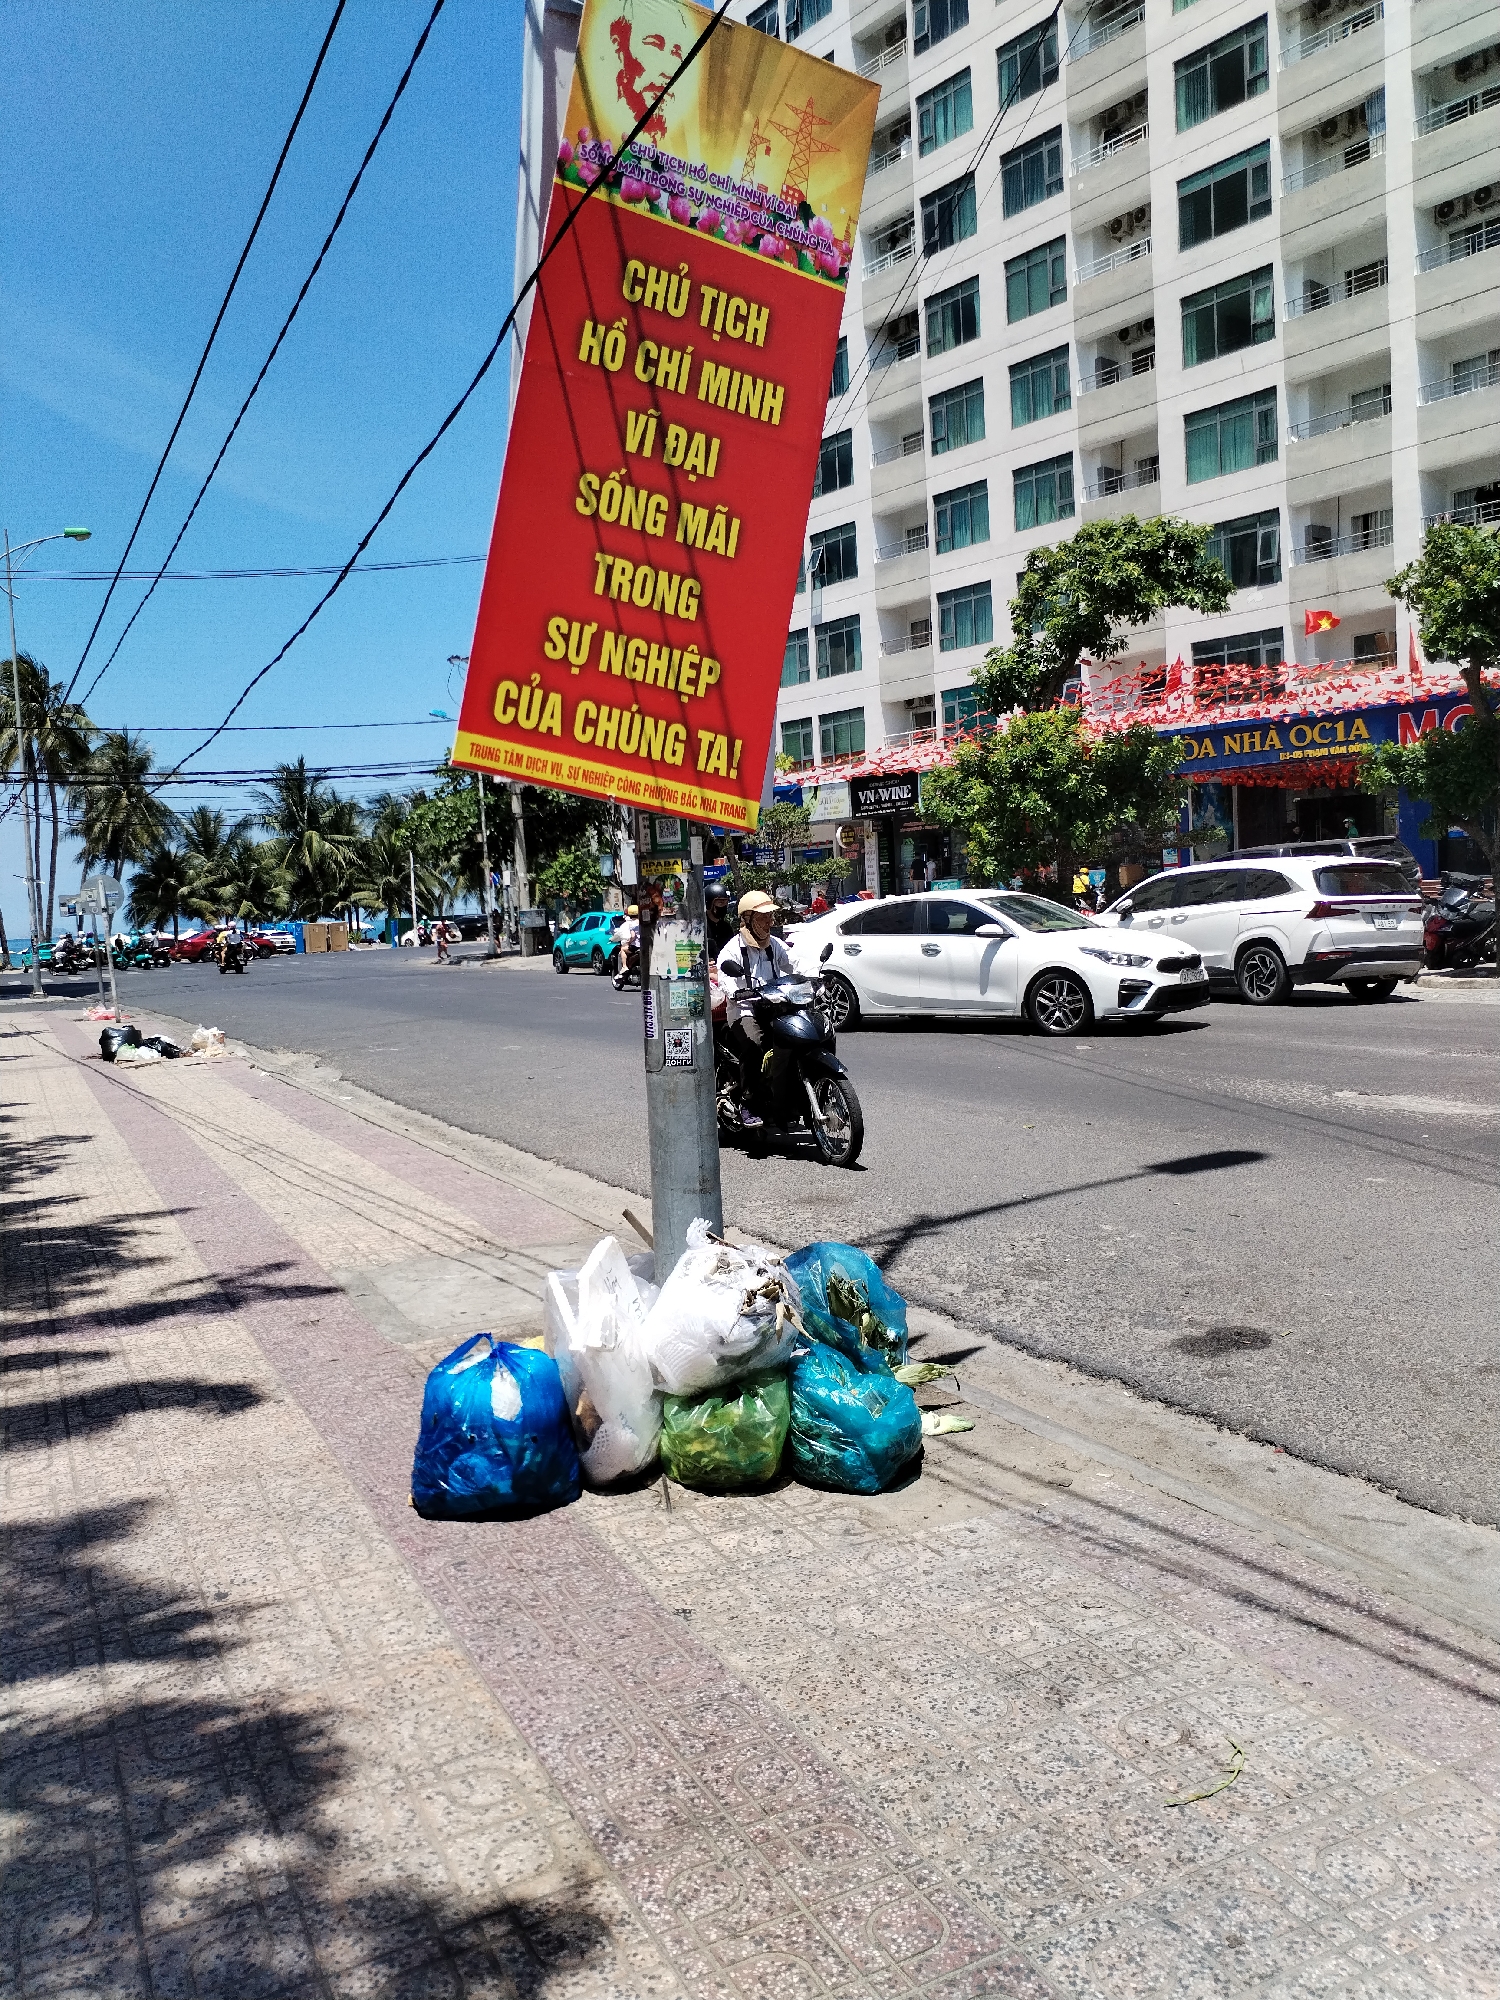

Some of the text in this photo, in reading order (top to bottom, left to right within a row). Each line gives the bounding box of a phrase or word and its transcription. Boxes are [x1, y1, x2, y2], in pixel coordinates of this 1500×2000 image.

[619, 160, 642, 180] MÃI
[643, 168, 686, 195] TRONG
[687, 186, 706, 205] SỰ
[706, 194, 750, 222] NGHIỆP
[750, 211, 774, 231] CỦA
[776, 222, 818, 249] CHÚNG
[818, 237, 834, 256] TA
[629, 140, 797, 221] CHỦ TỊCH HỒ CHÍ MINH VĨ ĐẠI
[622, 259, 770, 348] CHỦ TỊCH
[578, 316, 785, 426] HỒ CHÍ MINH
[625, 408, 721, 482] VĨ ĐẠI
[575, 468, 741, 558] SỐNG MÃI
[594, 552, 701, 621] TRONG
[544, 616, 721, 703] SỰ NGHIỆP
[493, 672, 743, 780] CỦA CHÚNG TA!
[1223, 724, 1283, 756] NHÀ
[1289, 718, 1371, 747] OC1A
[469, 742, 747, 821] TRUNG TÂM DỊCH VỤ, SỰ NGHIỆP CÔNG PHƯỜNG BẮC NHA TRANG
[858, 789, 874, 804] VN
[879, 784, 912, 802] WINE
[642, 859, 681, 870] ПРАВА
[665, 1059, 692, 1067] ДОНГИ
